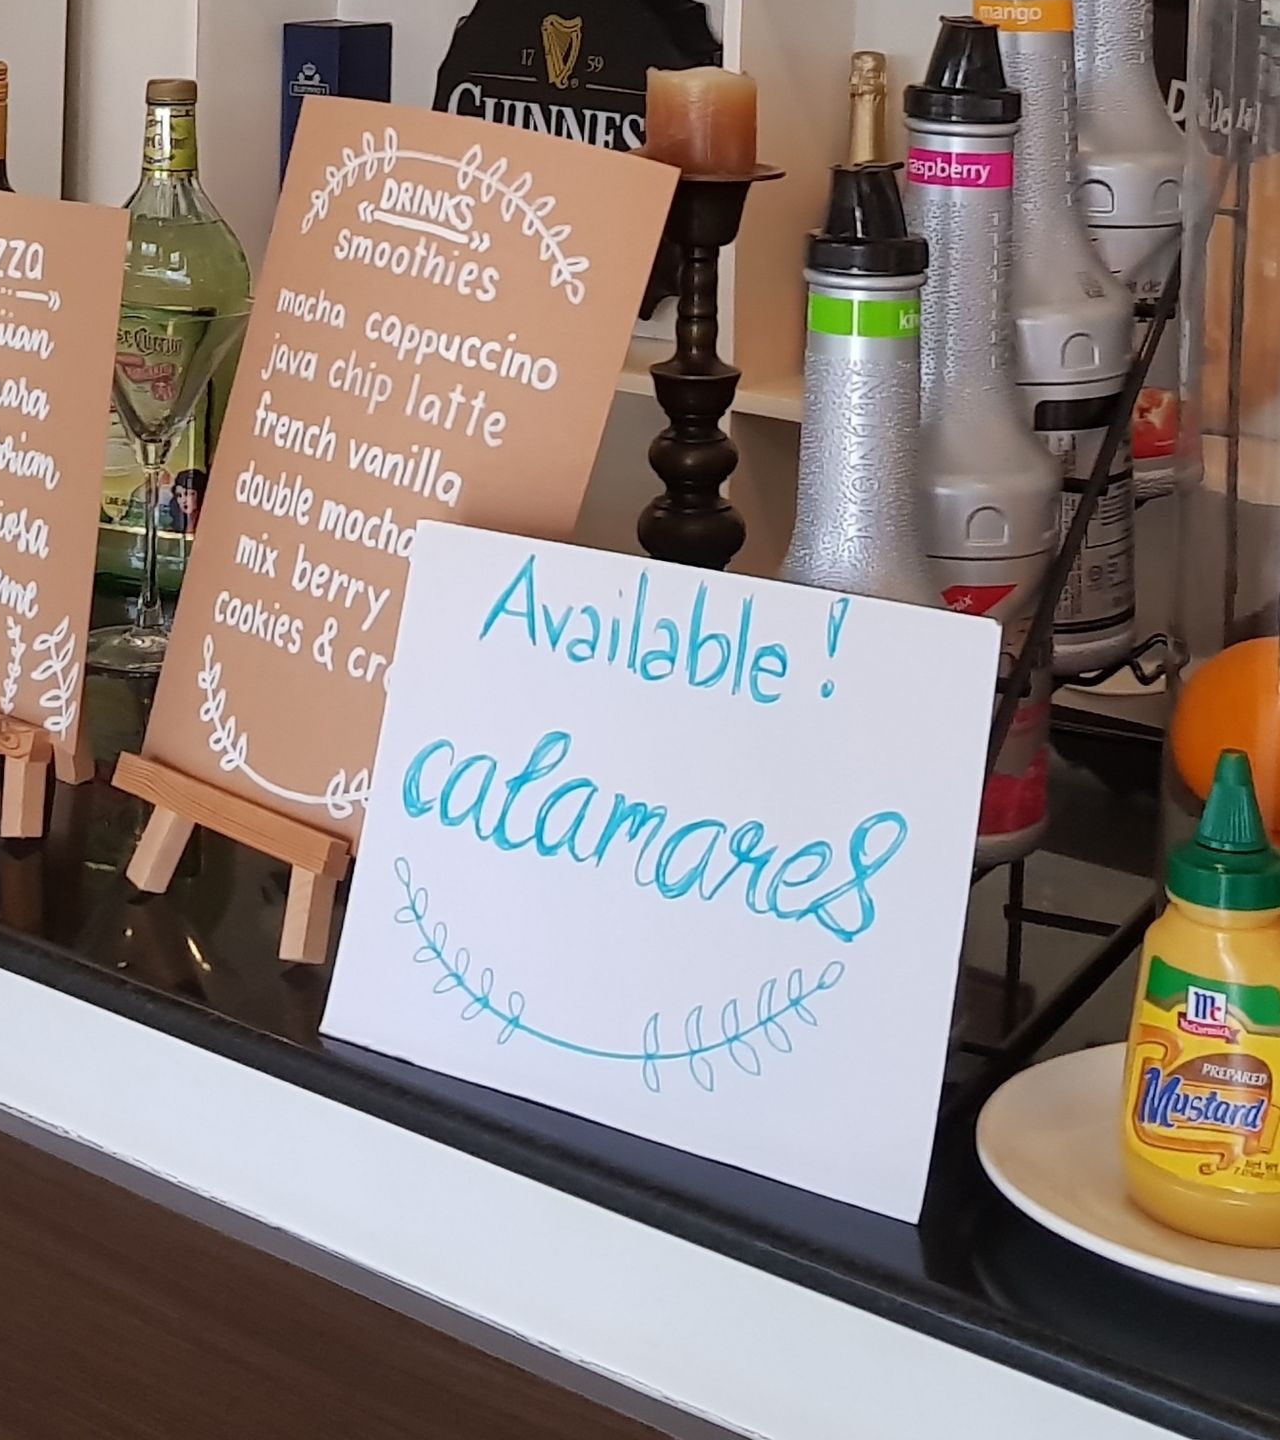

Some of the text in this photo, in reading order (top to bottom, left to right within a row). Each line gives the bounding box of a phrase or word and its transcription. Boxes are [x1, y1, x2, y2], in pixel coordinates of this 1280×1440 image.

[979, 5, 1042, 25] mango
[520, 48, 605, 73] 17 59
[447, 81, 647, 152] GUINNES
[379, 176, 475, 232] DRINKS
[333, 227, 500, 303] smoothies
[276, 286, 560, 392] mocha cappuccino
[260, 335, 509, 449] java chip latte
[252, 391, 464, 507] french vanilla
[234, 460, 416, 559] double mocha
[234, 531, 391, 631] mix berry
[213, 588, 304, 657] cookies
[311, 621, 339, 672] &
[402, 730, 909, 944] calamares
[1139, 1066, 1266, 1132] Mustard
[1200, 1062, 1269, 1087] PREPARED
